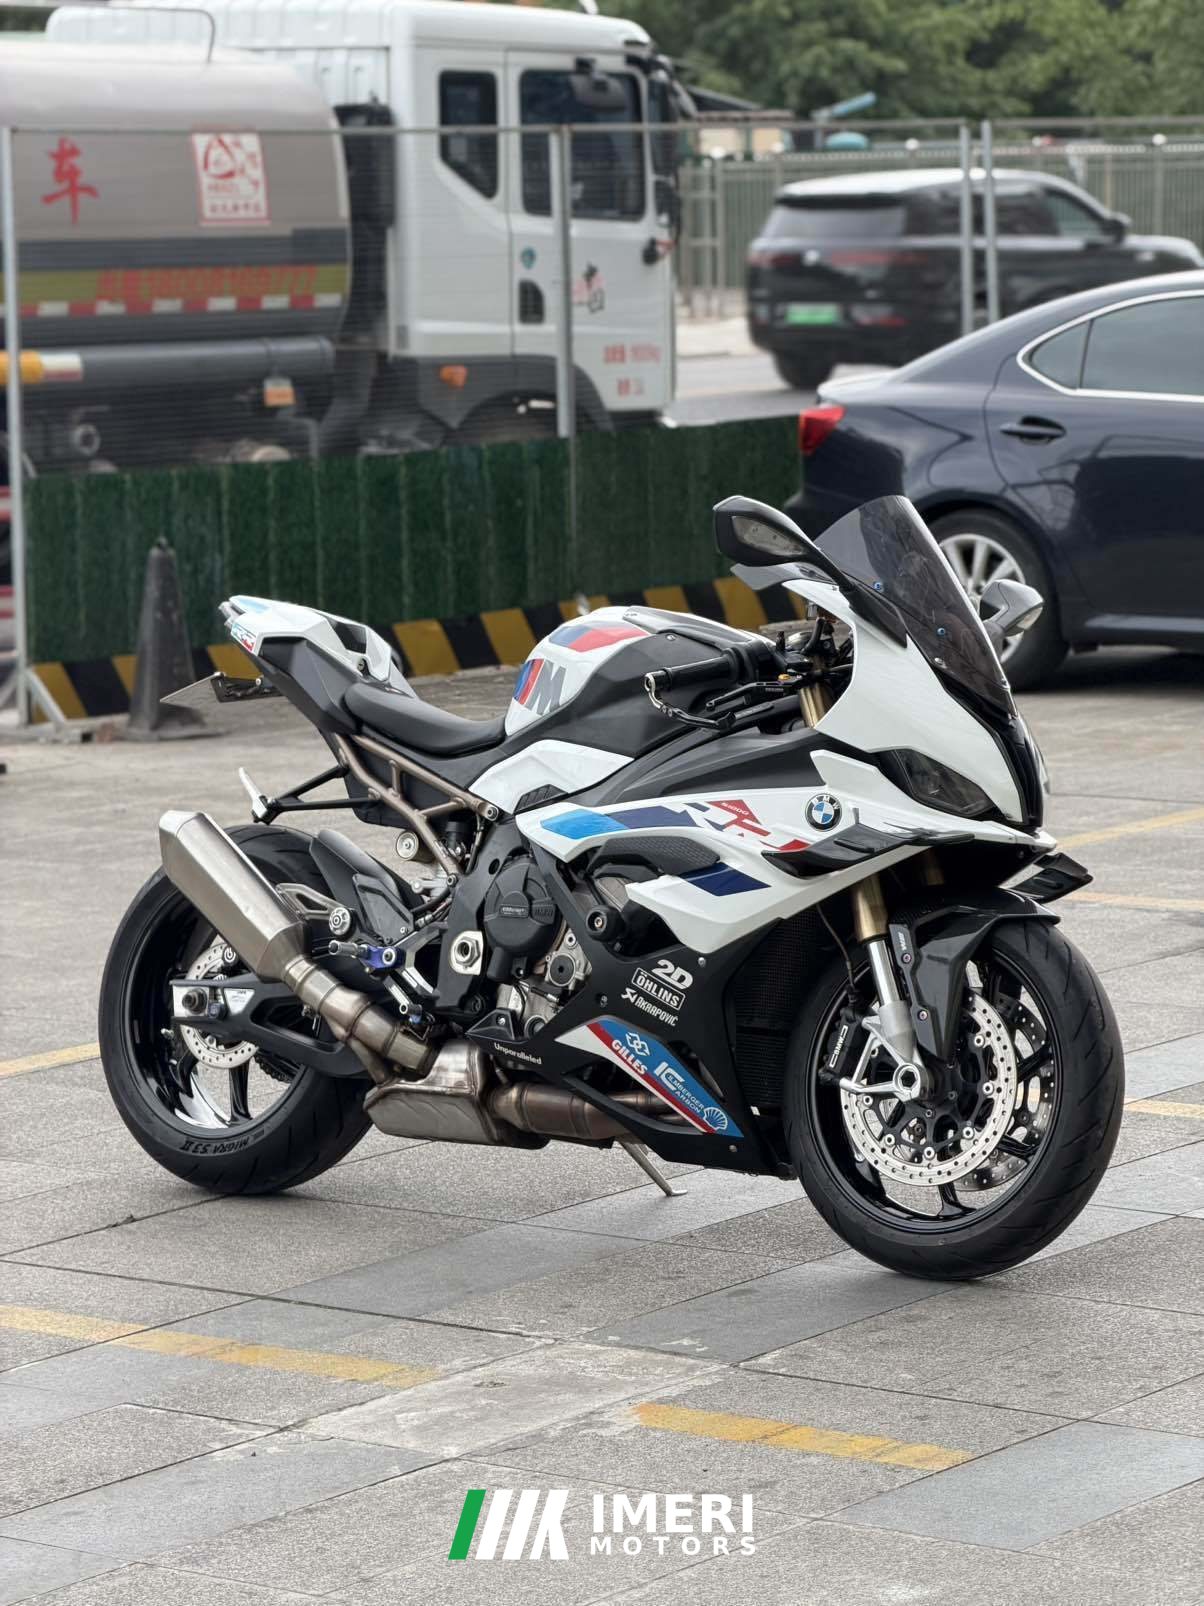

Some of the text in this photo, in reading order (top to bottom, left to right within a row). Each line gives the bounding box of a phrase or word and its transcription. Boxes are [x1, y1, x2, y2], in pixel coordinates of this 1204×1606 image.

[40, 137, 99, 225] 车
[636, 971, 680, 1007] ÖHLINS
[651, 959, 694, 990] 2D
[493, 1041, 542, 1065] Unparalleled
[611, 1039, 648, 1075] GILLES
